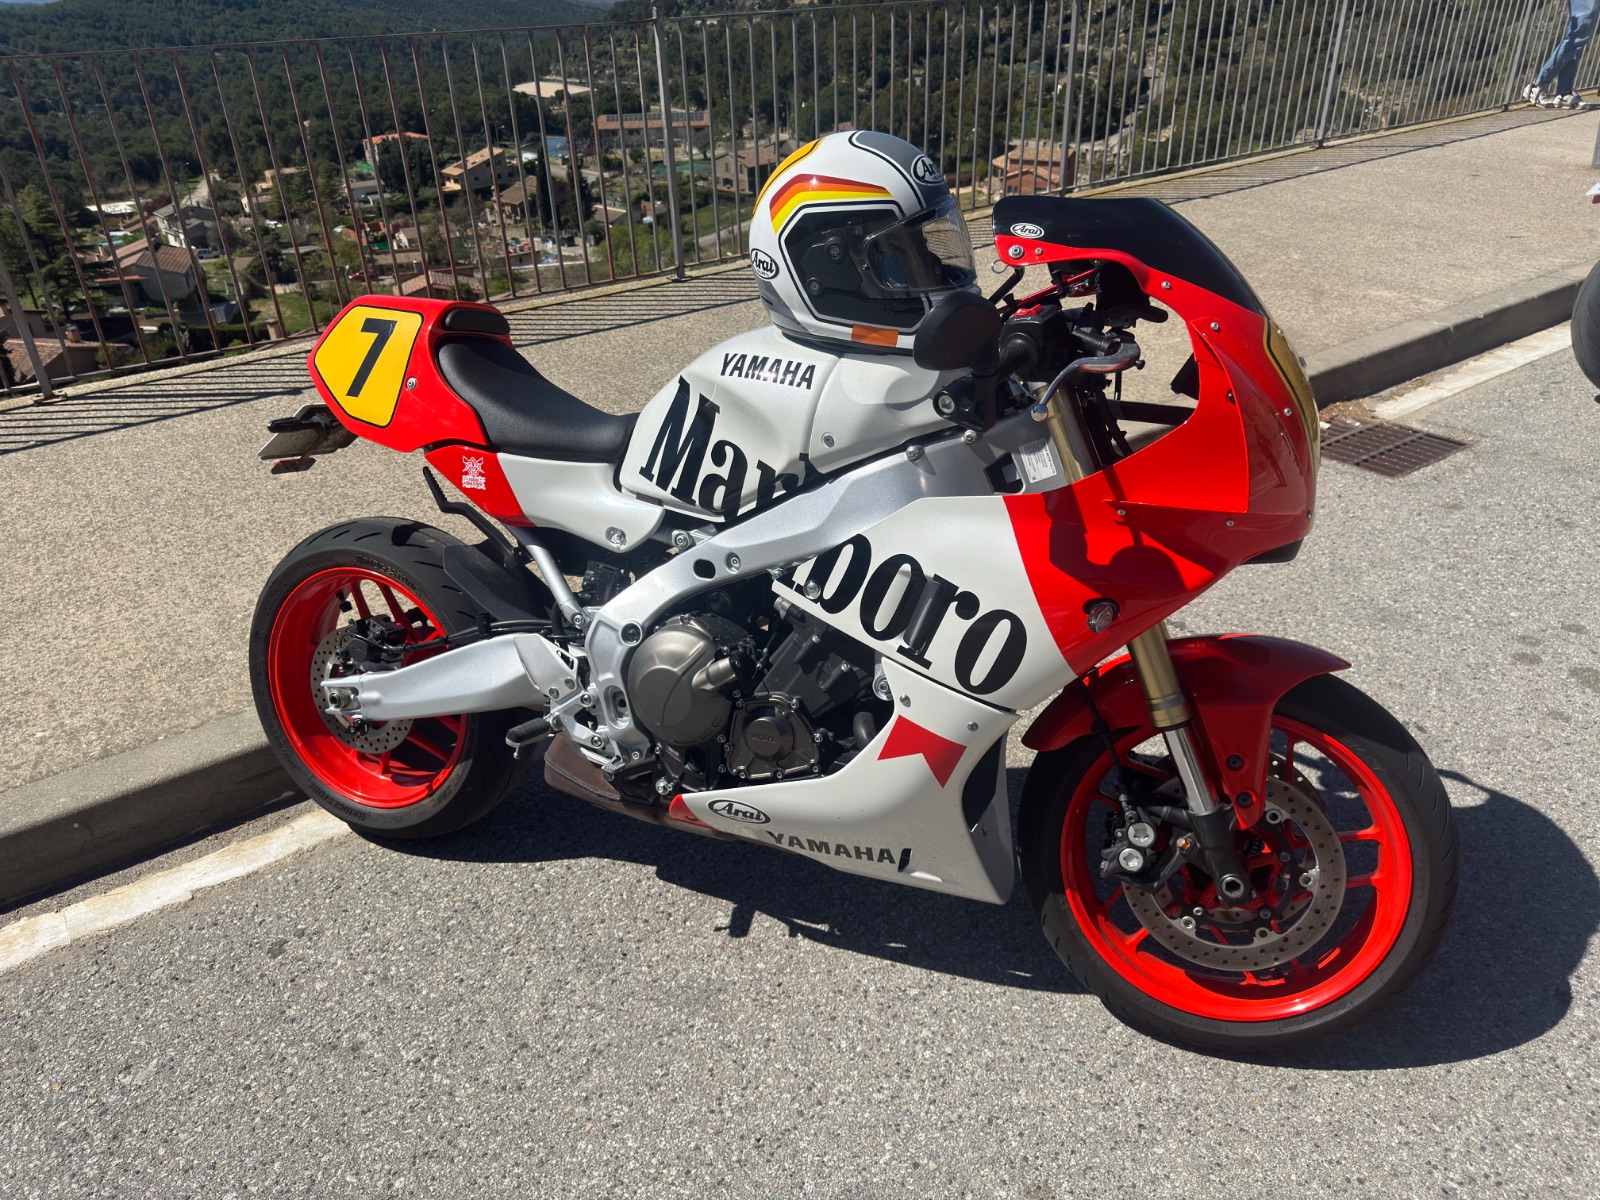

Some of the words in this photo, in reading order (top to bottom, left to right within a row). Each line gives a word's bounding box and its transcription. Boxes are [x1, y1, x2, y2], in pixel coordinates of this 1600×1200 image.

[1013, 225, 1040, 235] Arai
[752, 251, 774, 273] Arai
[346, 318, 397, 398] 7
[720, 353, 816, 390] YAMAHA
[713, 802, 764, 821] Arai
[766, 830, 897, 865] YAMAHA
